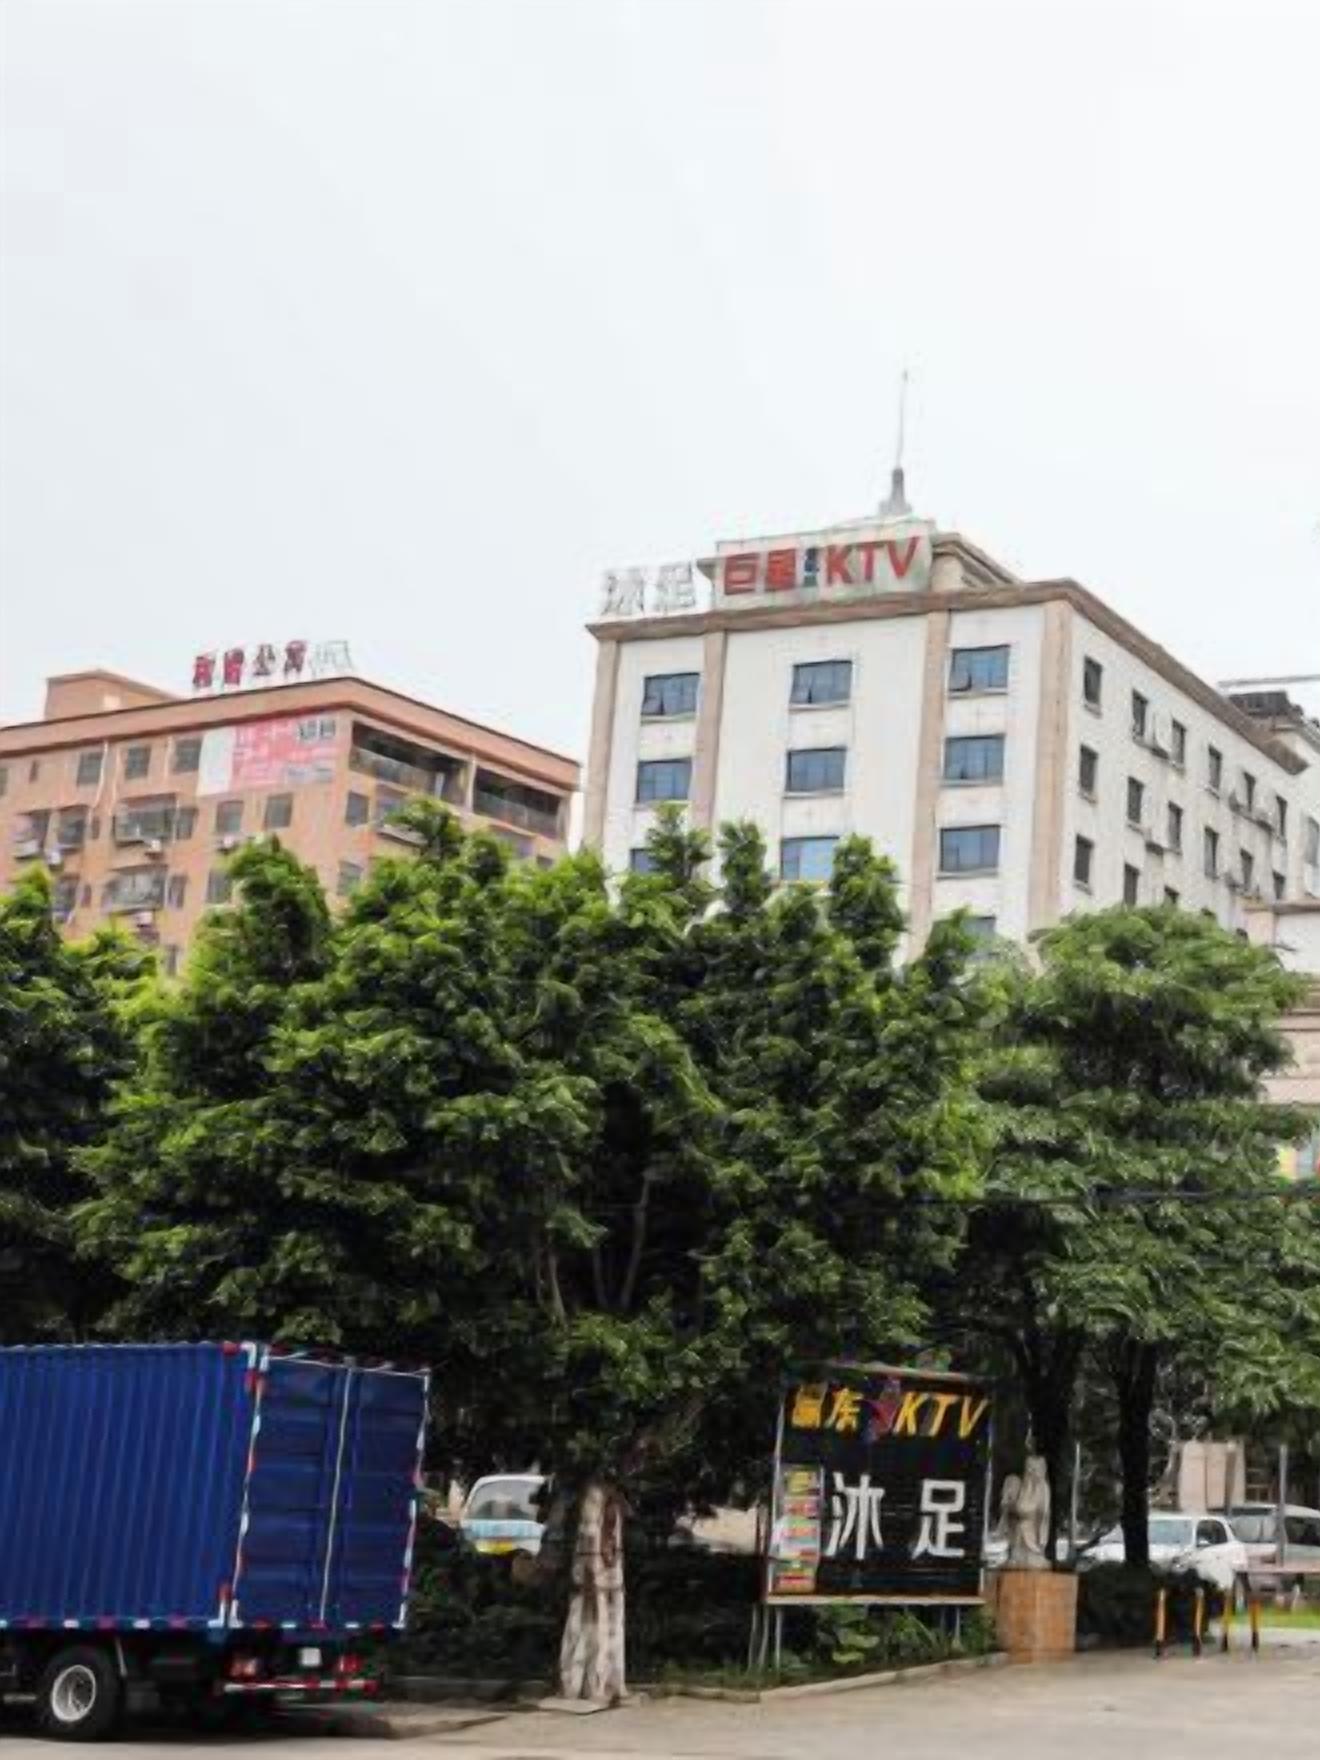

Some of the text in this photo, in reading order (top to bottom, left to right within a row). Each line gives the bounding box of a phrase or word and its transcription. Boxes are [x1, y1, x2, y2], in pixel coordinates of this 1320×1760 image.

[825, 537, 920, 585] KTV
[893, 1391, 989, 1439] KTV
[825, 1471, 966, 1560] 沐足
